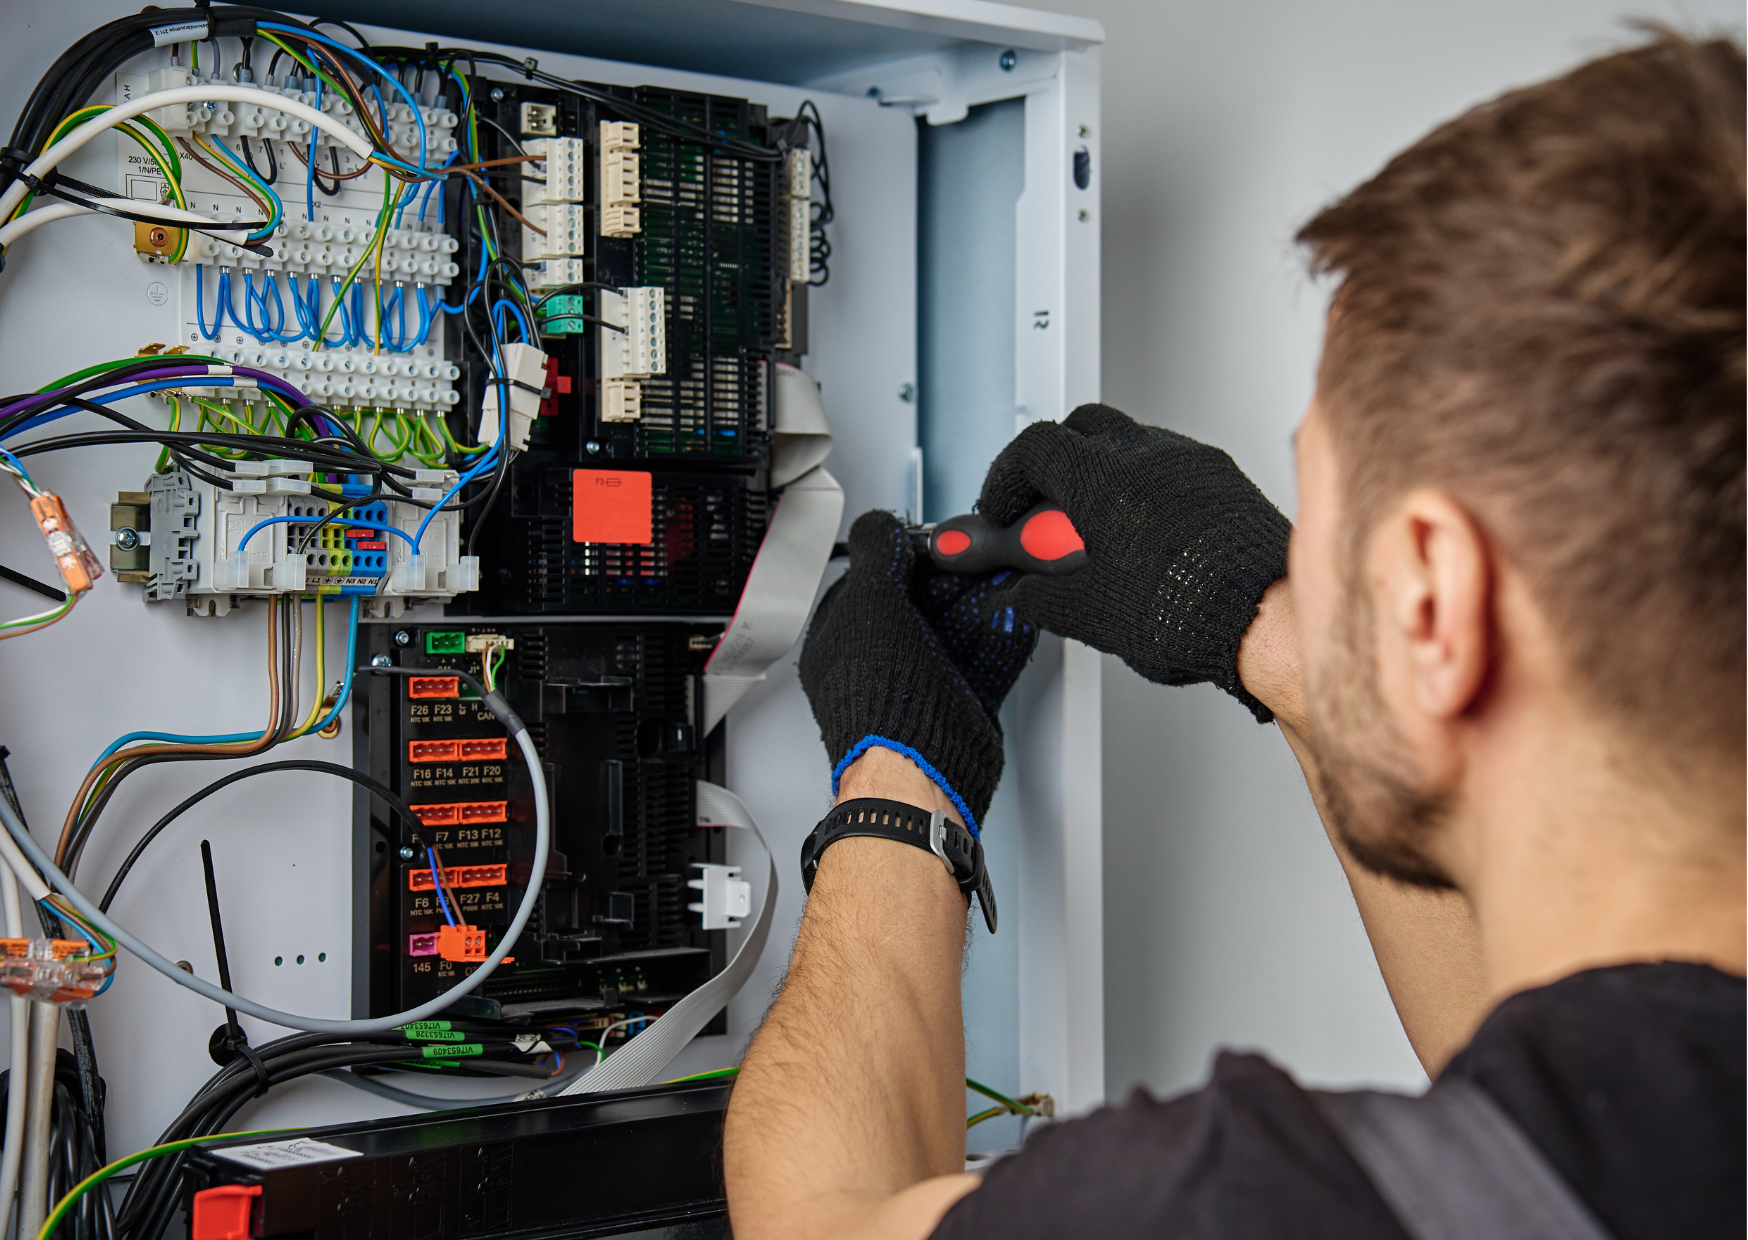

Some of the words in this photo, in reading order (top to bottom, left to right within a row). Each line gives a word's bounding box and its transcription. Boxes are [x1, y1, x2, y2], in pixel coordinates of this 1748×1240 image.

[128, 156, 141, 164] 230
[138, 166, 162, 175] 1/N/PE
[411, 705, 428, 715] F26
[435, 704, 452, 714] F23
[472, 703, 478, 711] H
[477, 712, 495, 720] CAN
[414, 769, 431, 779] F16
[436, 768, 453, 778] F14
[463, 767, 479, 776] F21
[484, 766, 501, 776] F20
[412, 834, 419, 843] F
[436, 832, 449, 841] F7
[459, 830, 478, 840] F13
[482, 829, 501, 839] F12
[415, 898, 429, 908] F6
[460, 894, 480, 904] F27
[486, 892, 499, 902] F4
[413, 962, 431, 972] 145
[440, 961, 452, 971] F0
[433, 1047, 474, 1056] VI7653409
